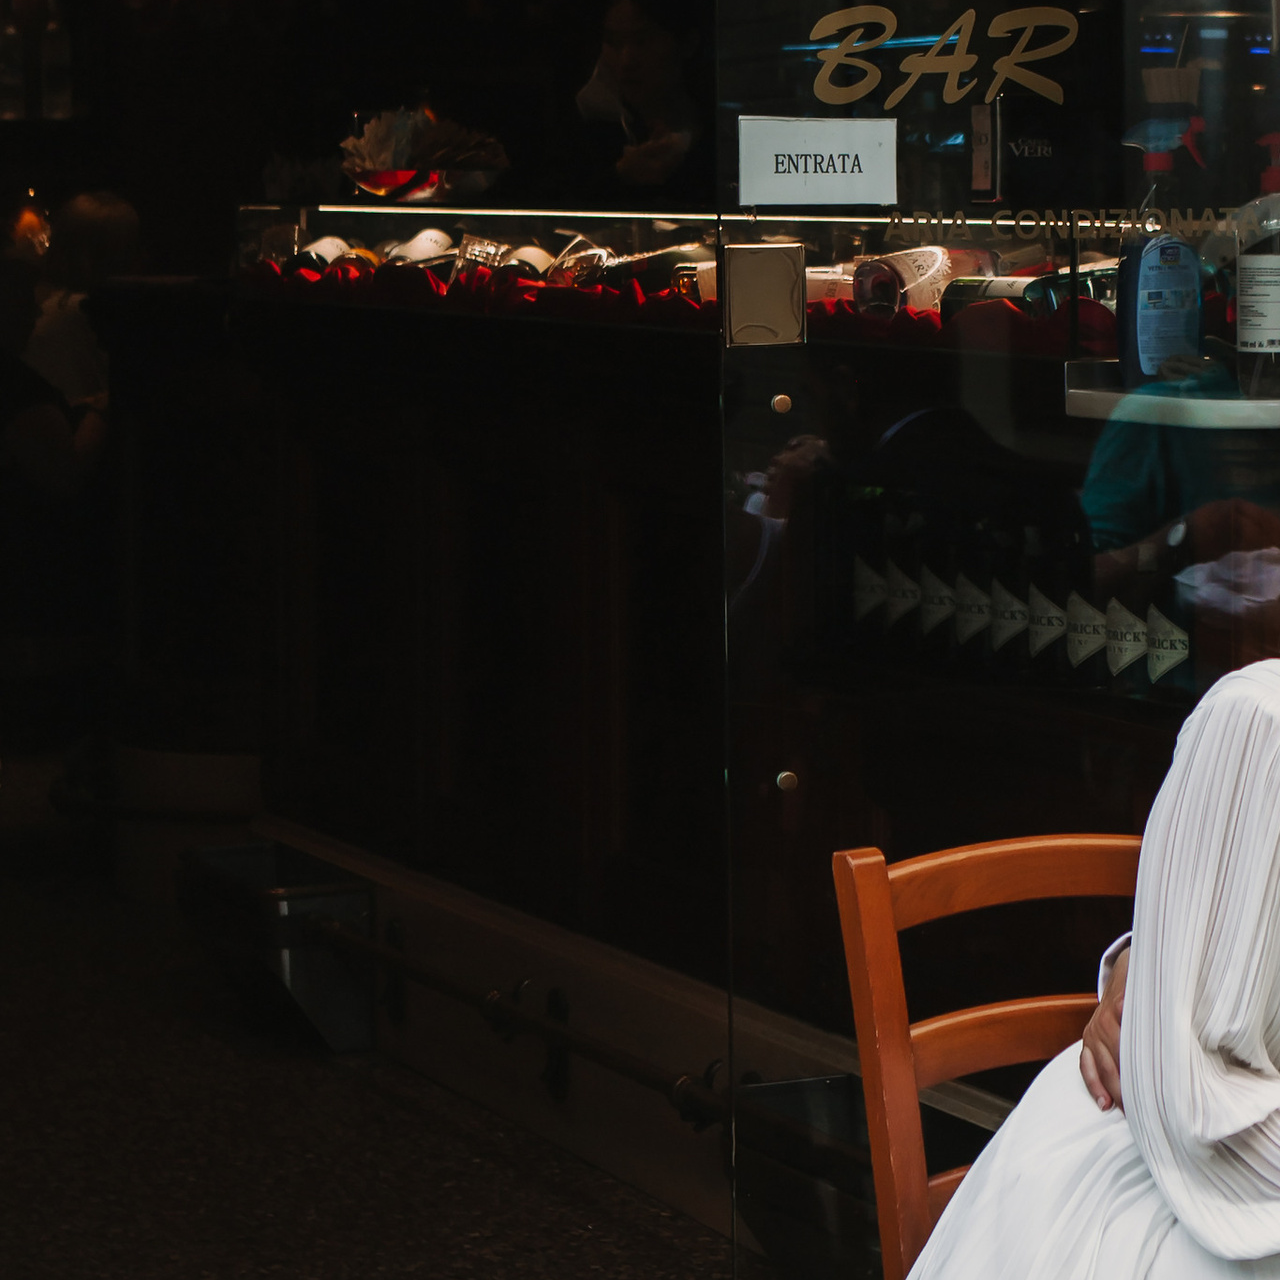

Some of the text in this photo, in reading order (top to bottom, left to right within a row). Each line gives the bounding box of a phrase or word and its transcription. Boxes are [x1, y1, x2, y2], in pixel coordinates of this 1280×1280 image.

[809, 5, 1078, 111] BAR
[773, 153, 863, 175] ENTRATA
[883, 207, 1264, 241] ARIA CONDIZIONATA
